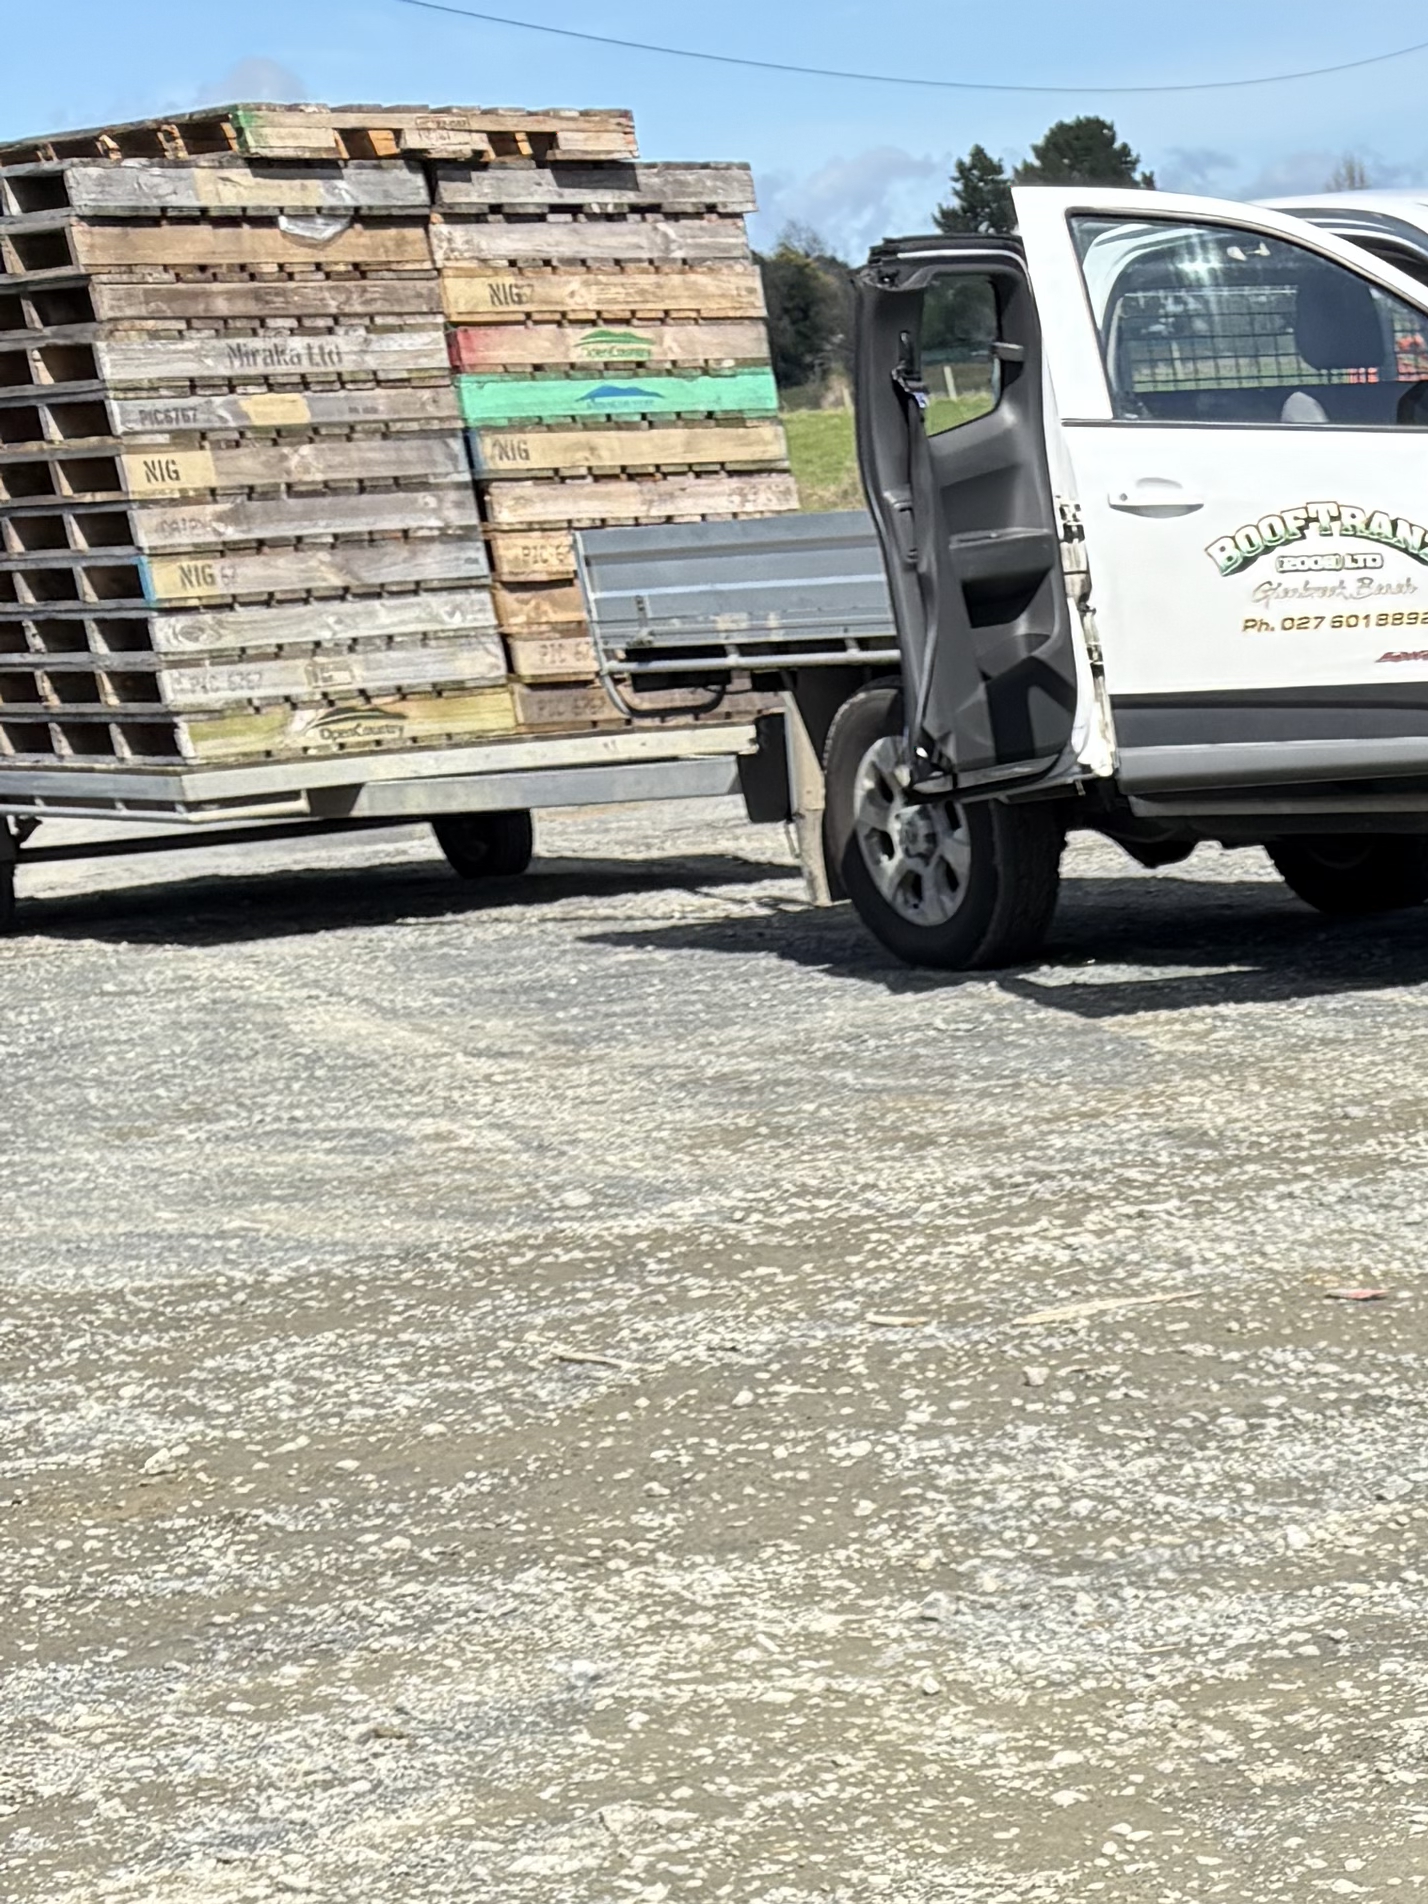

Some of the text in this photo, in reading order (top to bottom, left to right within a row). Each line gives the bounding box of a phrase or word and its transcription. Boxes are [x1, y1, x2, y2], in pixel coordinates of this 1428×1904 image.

[487, 282, 520, 306] NIG
[498, 440, 530, 462] NIG
[143, 459, 181, 482] NIG
[1343, 552, 1385, 570] LTD
[179, 564, 217, 588] NIG
[1242, 617, 1276, 633] Ph.
[1280, 614, 1327, 632] 027
